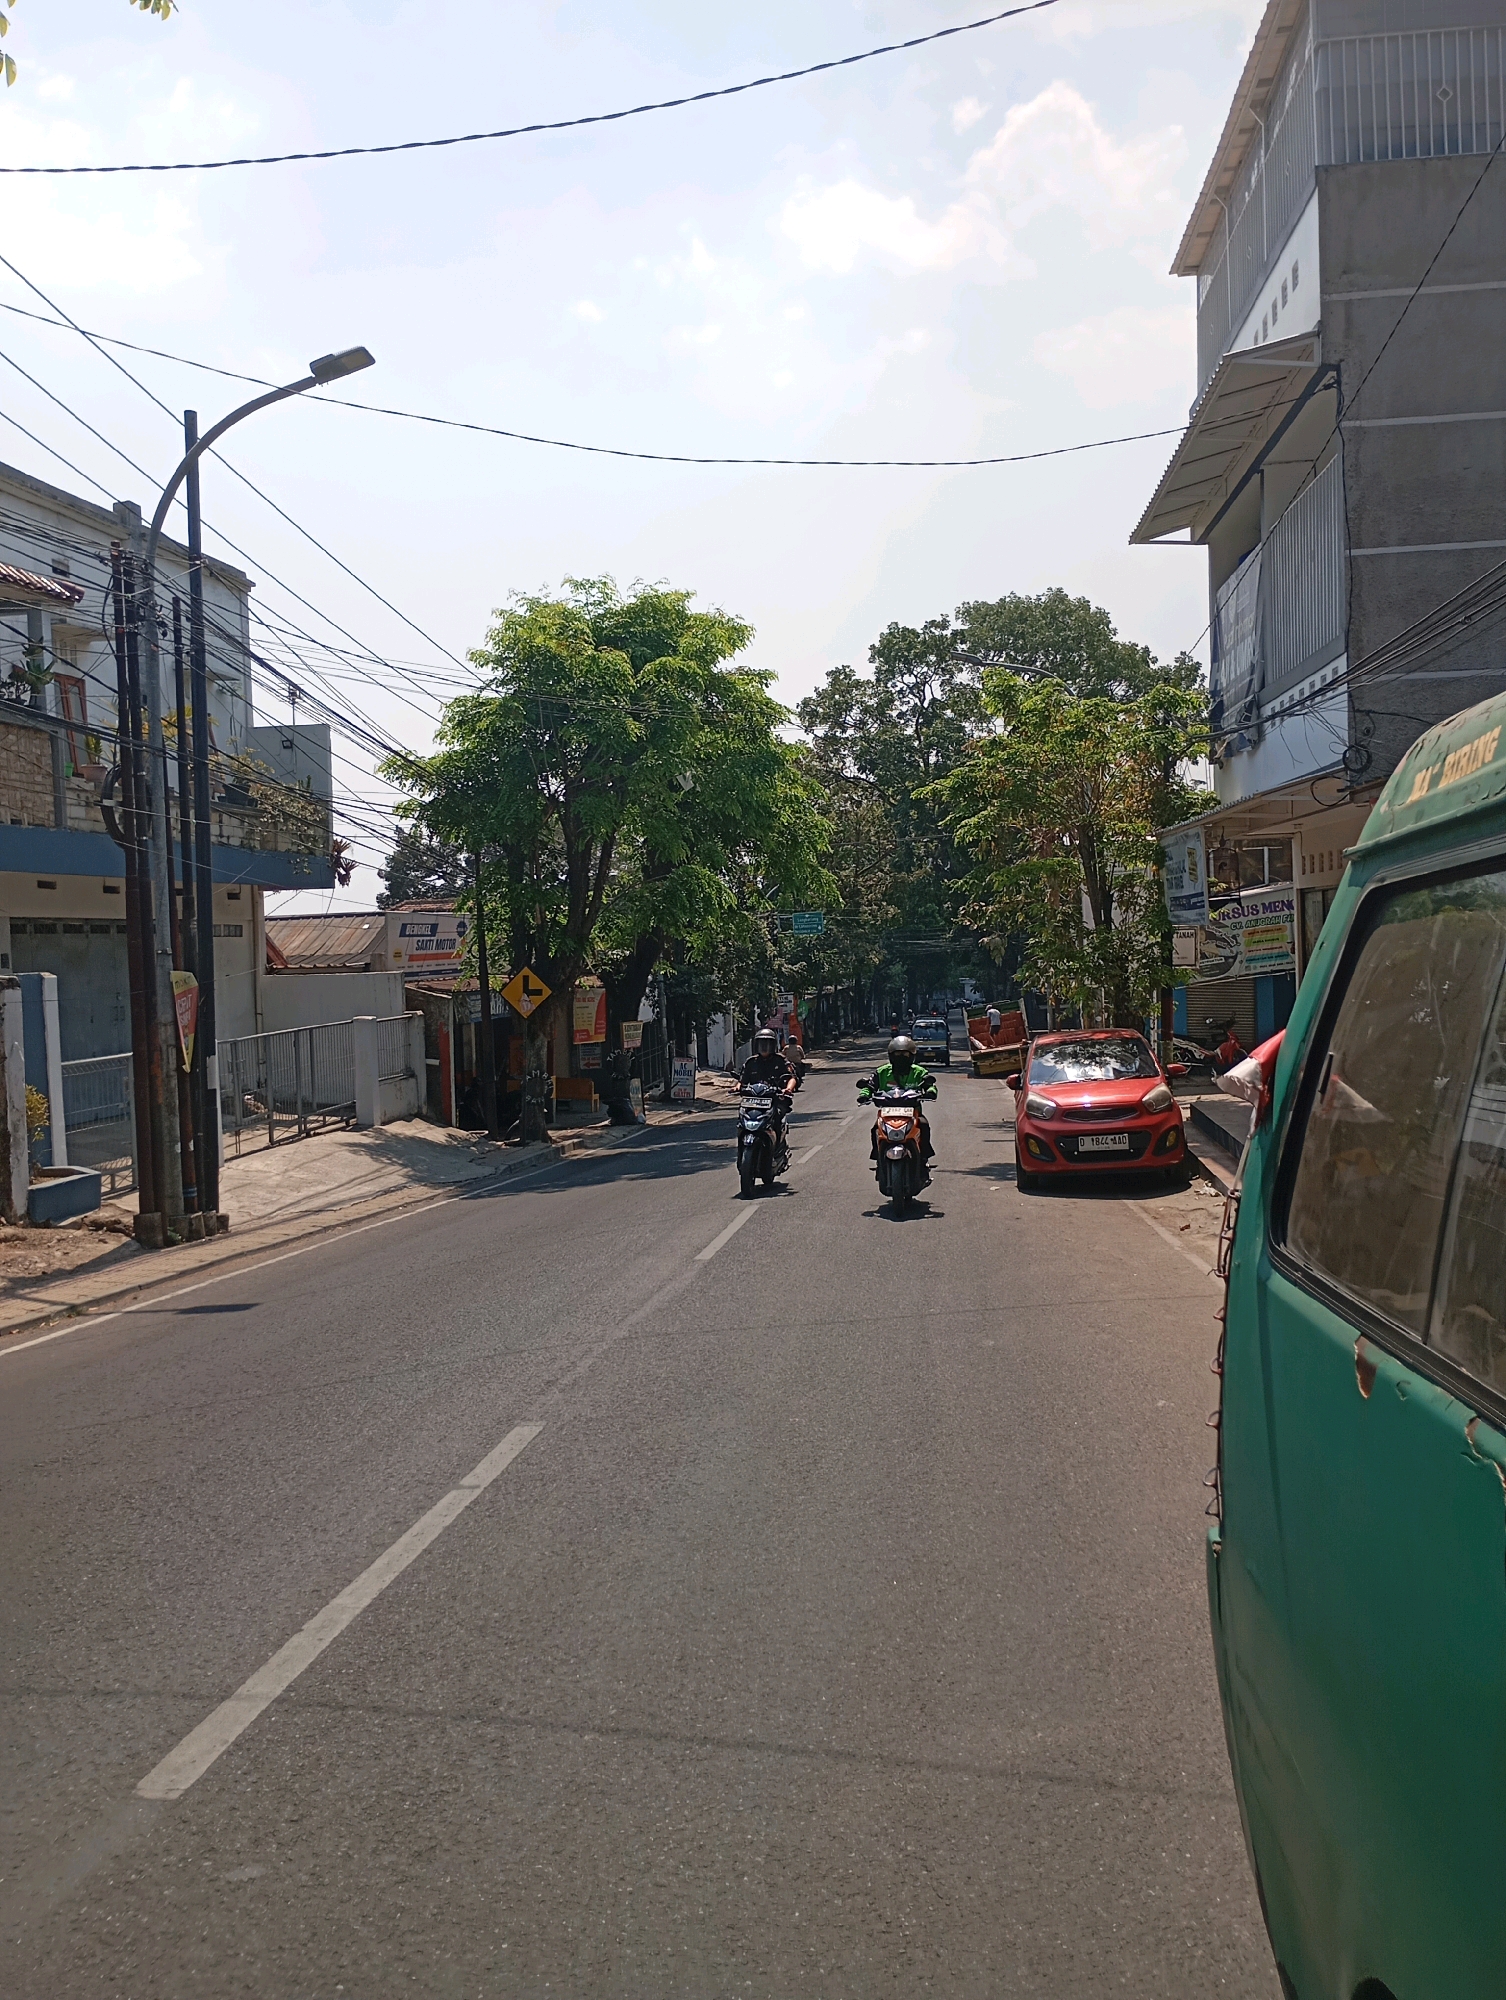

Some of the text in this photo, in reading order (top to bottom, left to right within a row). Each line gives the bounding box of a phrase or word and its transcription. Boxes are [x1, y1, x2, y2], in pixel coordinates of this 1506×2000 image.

[1210, 904, 1259, 921] URSUS
[1245, 915, 1281, 929] ANUGRAH
[405, 924, 432, 935] BENGKEL
[1176, 931, 1195, 939] TANAH
[415, 938, 457, 951] SAKTI MOTOR
[680, 1062, 688, 1070] AC
[673, 1069, 693, 1077] MOBIL
[1080, 1137, 1085, 1147] D
[1091, 1136, 1109, 1146] 1844
